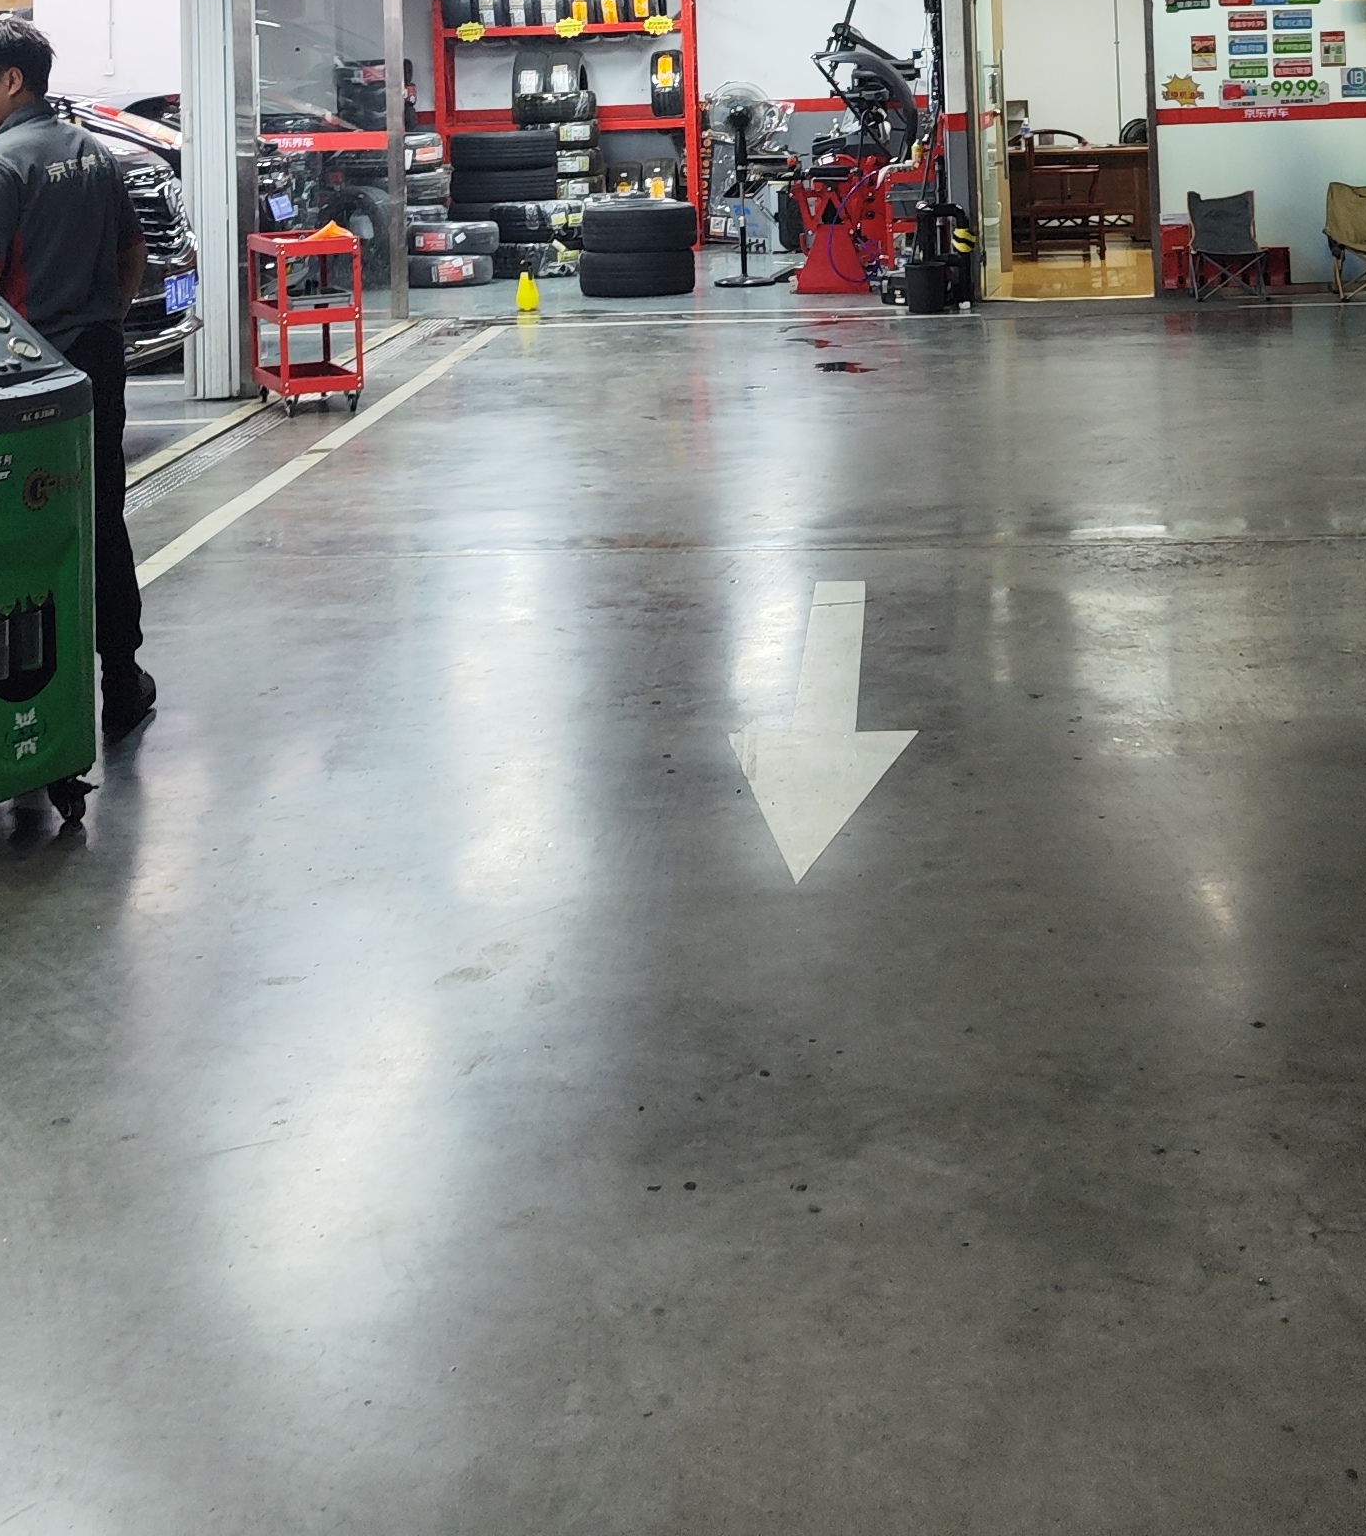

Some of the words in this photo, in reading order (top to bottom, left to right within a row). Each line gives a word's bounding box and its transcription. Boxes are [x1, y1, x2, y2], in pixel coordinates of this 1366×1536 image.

[1243, 107, 1290, 119] 京东养车
[44, 152, 110, 183] 京东养
